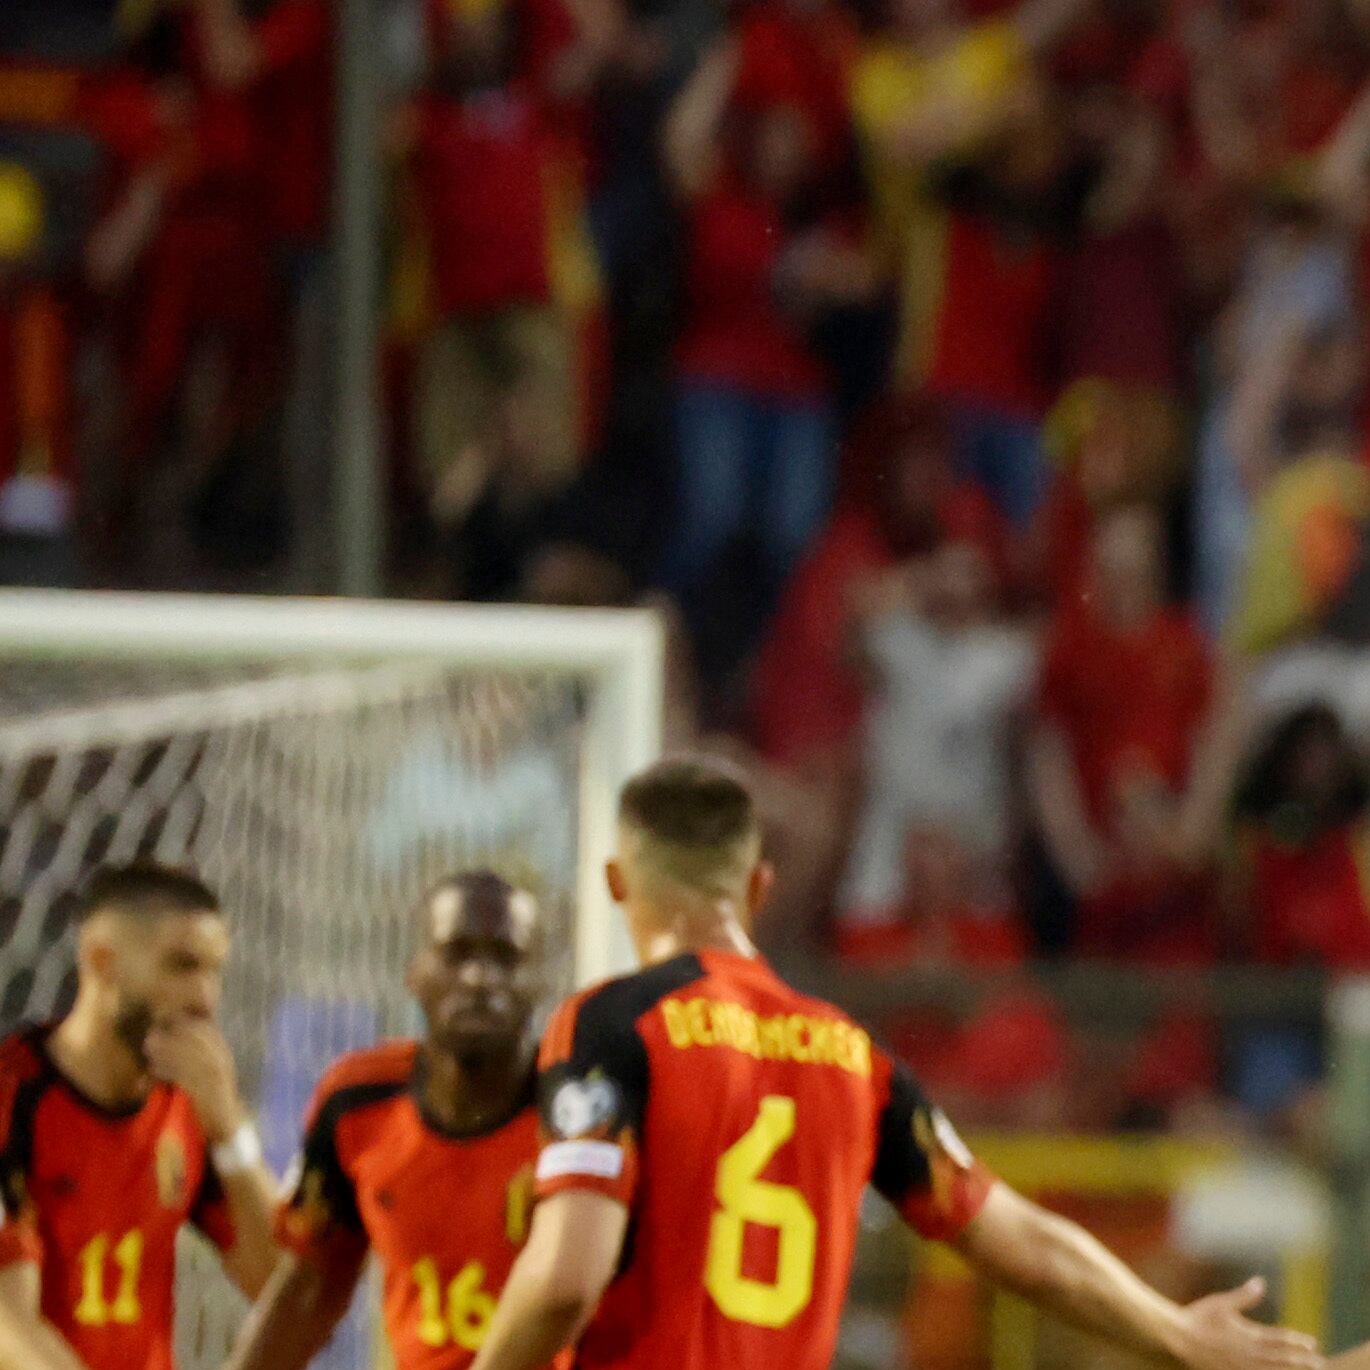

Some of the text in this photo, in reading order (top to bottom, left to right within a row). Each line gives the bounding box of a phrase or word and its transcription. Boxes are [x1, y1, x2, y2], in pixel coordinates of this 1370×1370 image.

[704, 1095, 817, 1328] 6
[74, 1229, 143, 1326] 11
[411, 1257, 498, 1352] 16
